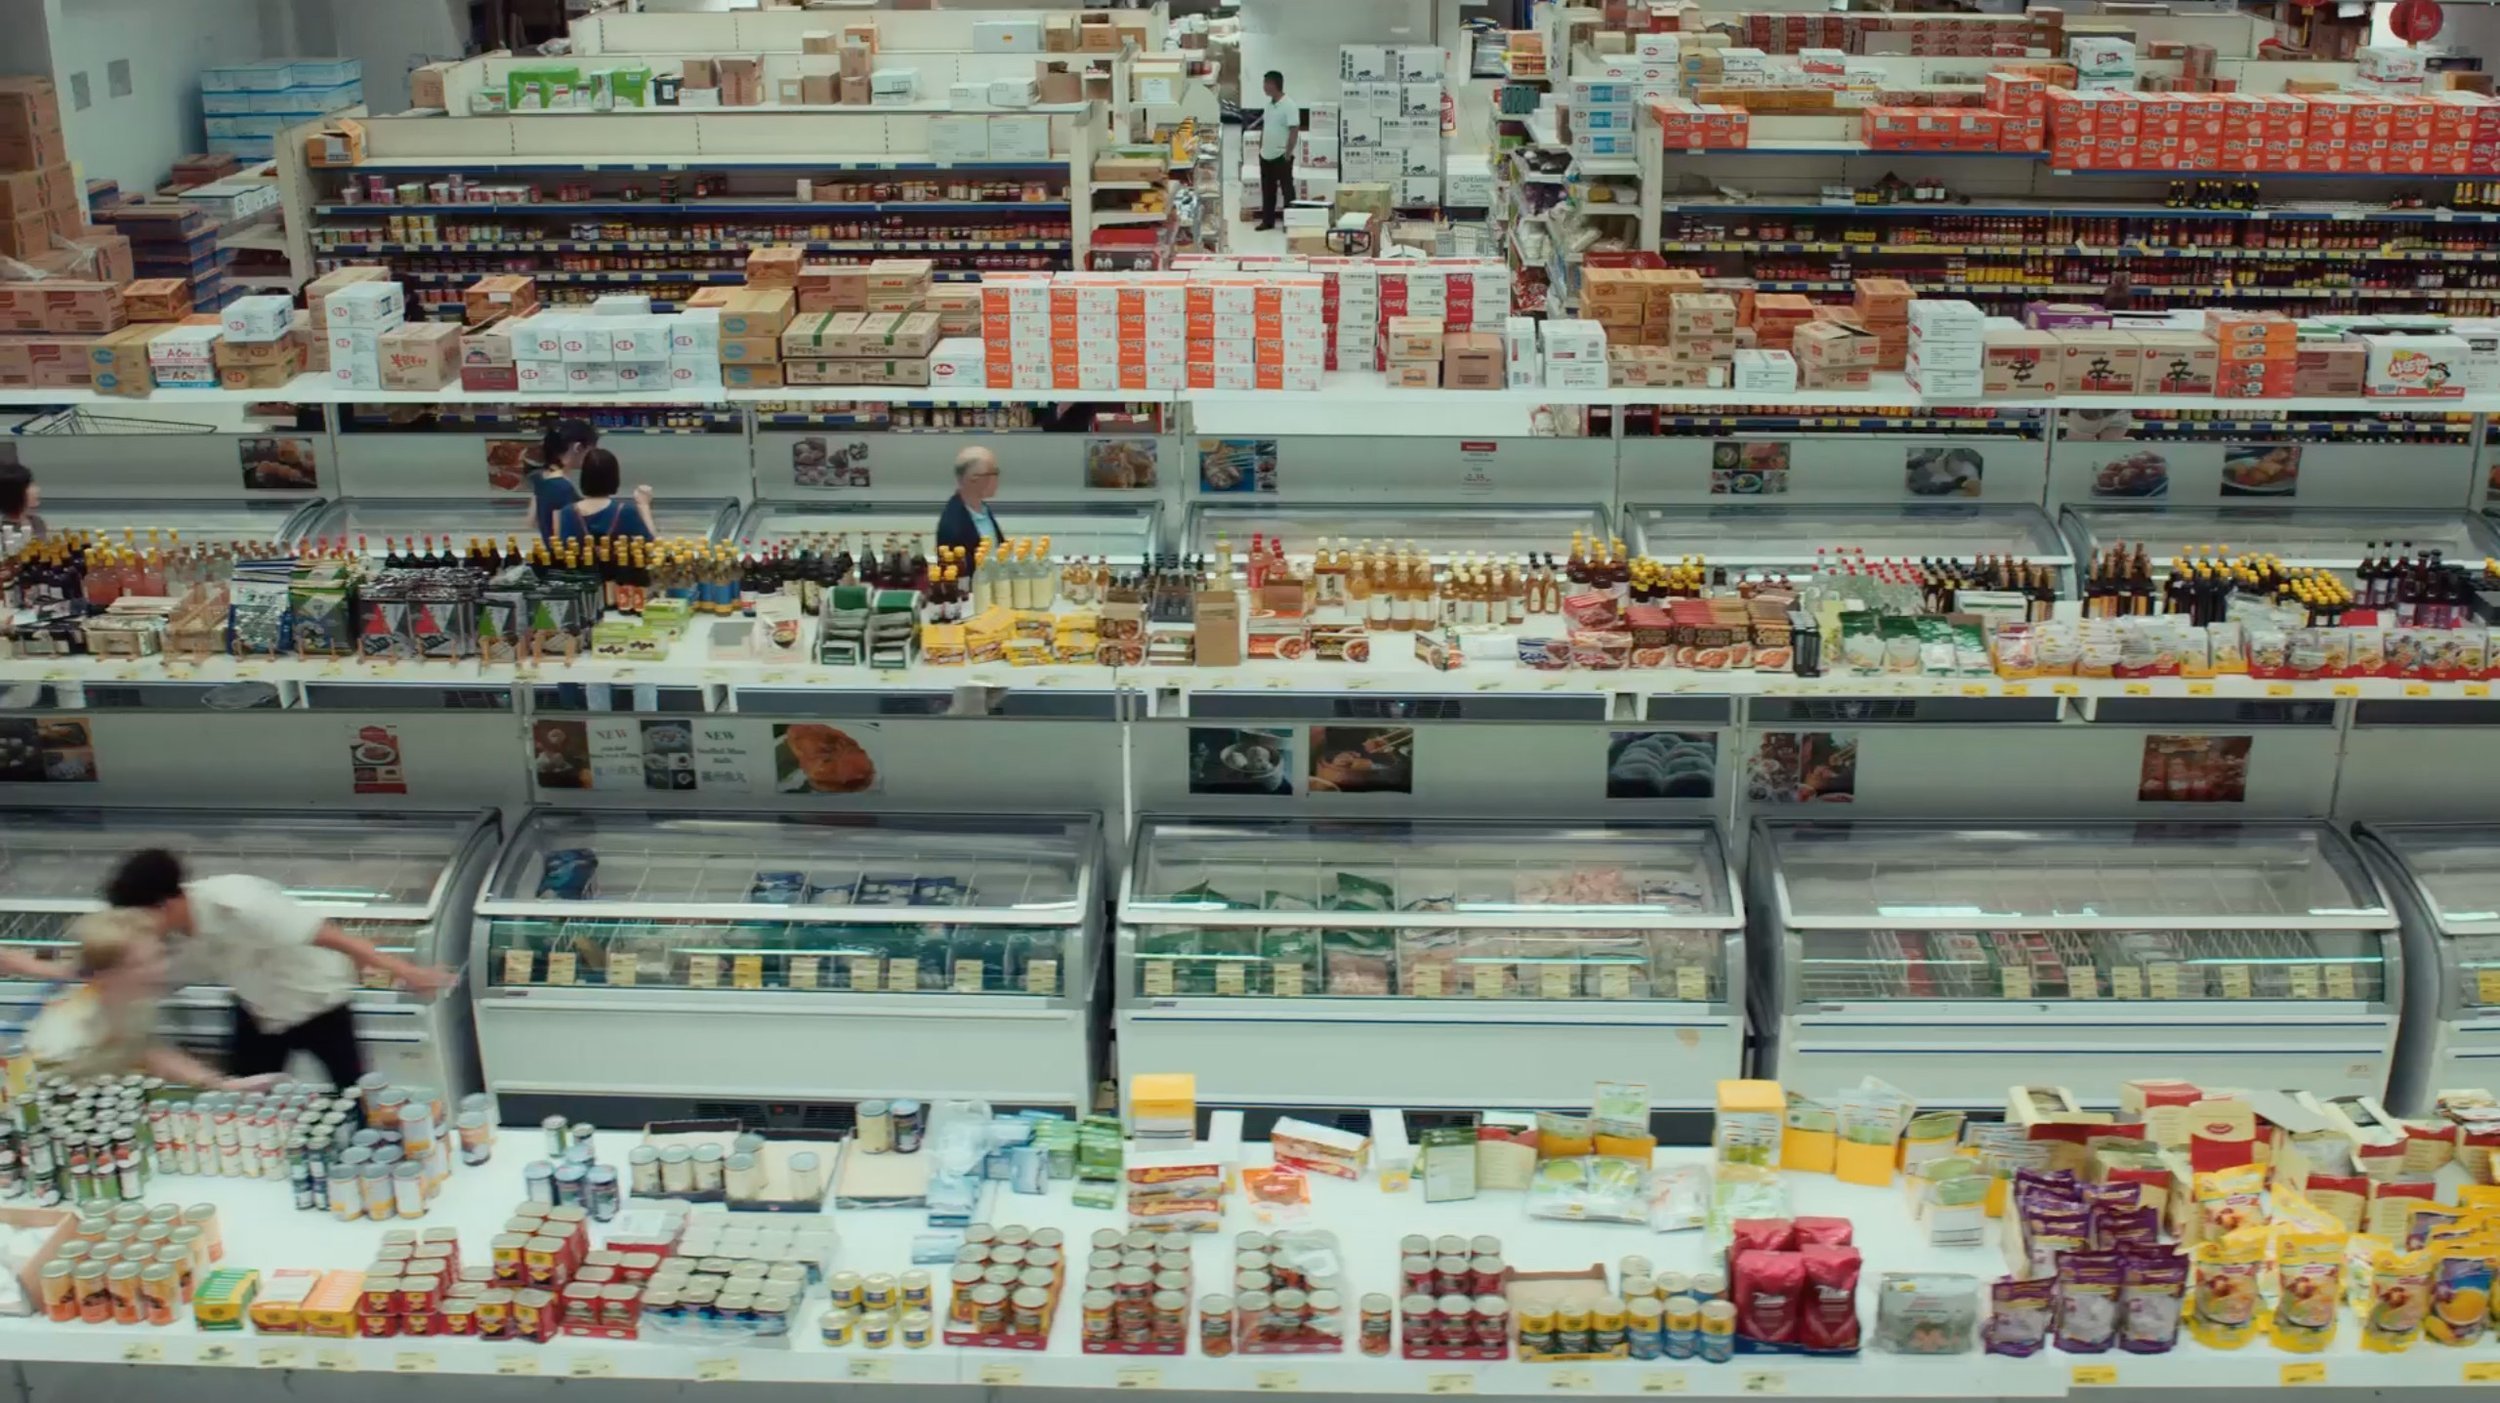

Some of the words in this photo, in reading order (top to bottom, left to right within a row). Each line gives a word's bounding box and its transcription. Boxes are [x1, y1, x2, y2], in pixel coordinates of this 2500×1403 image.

[2087, 357, 2115, 391] 辛
[2166, 358, 2194, 393] 辛
[596, 729, 627, 740] NEW
[704, 731, 735, 741] NEW
